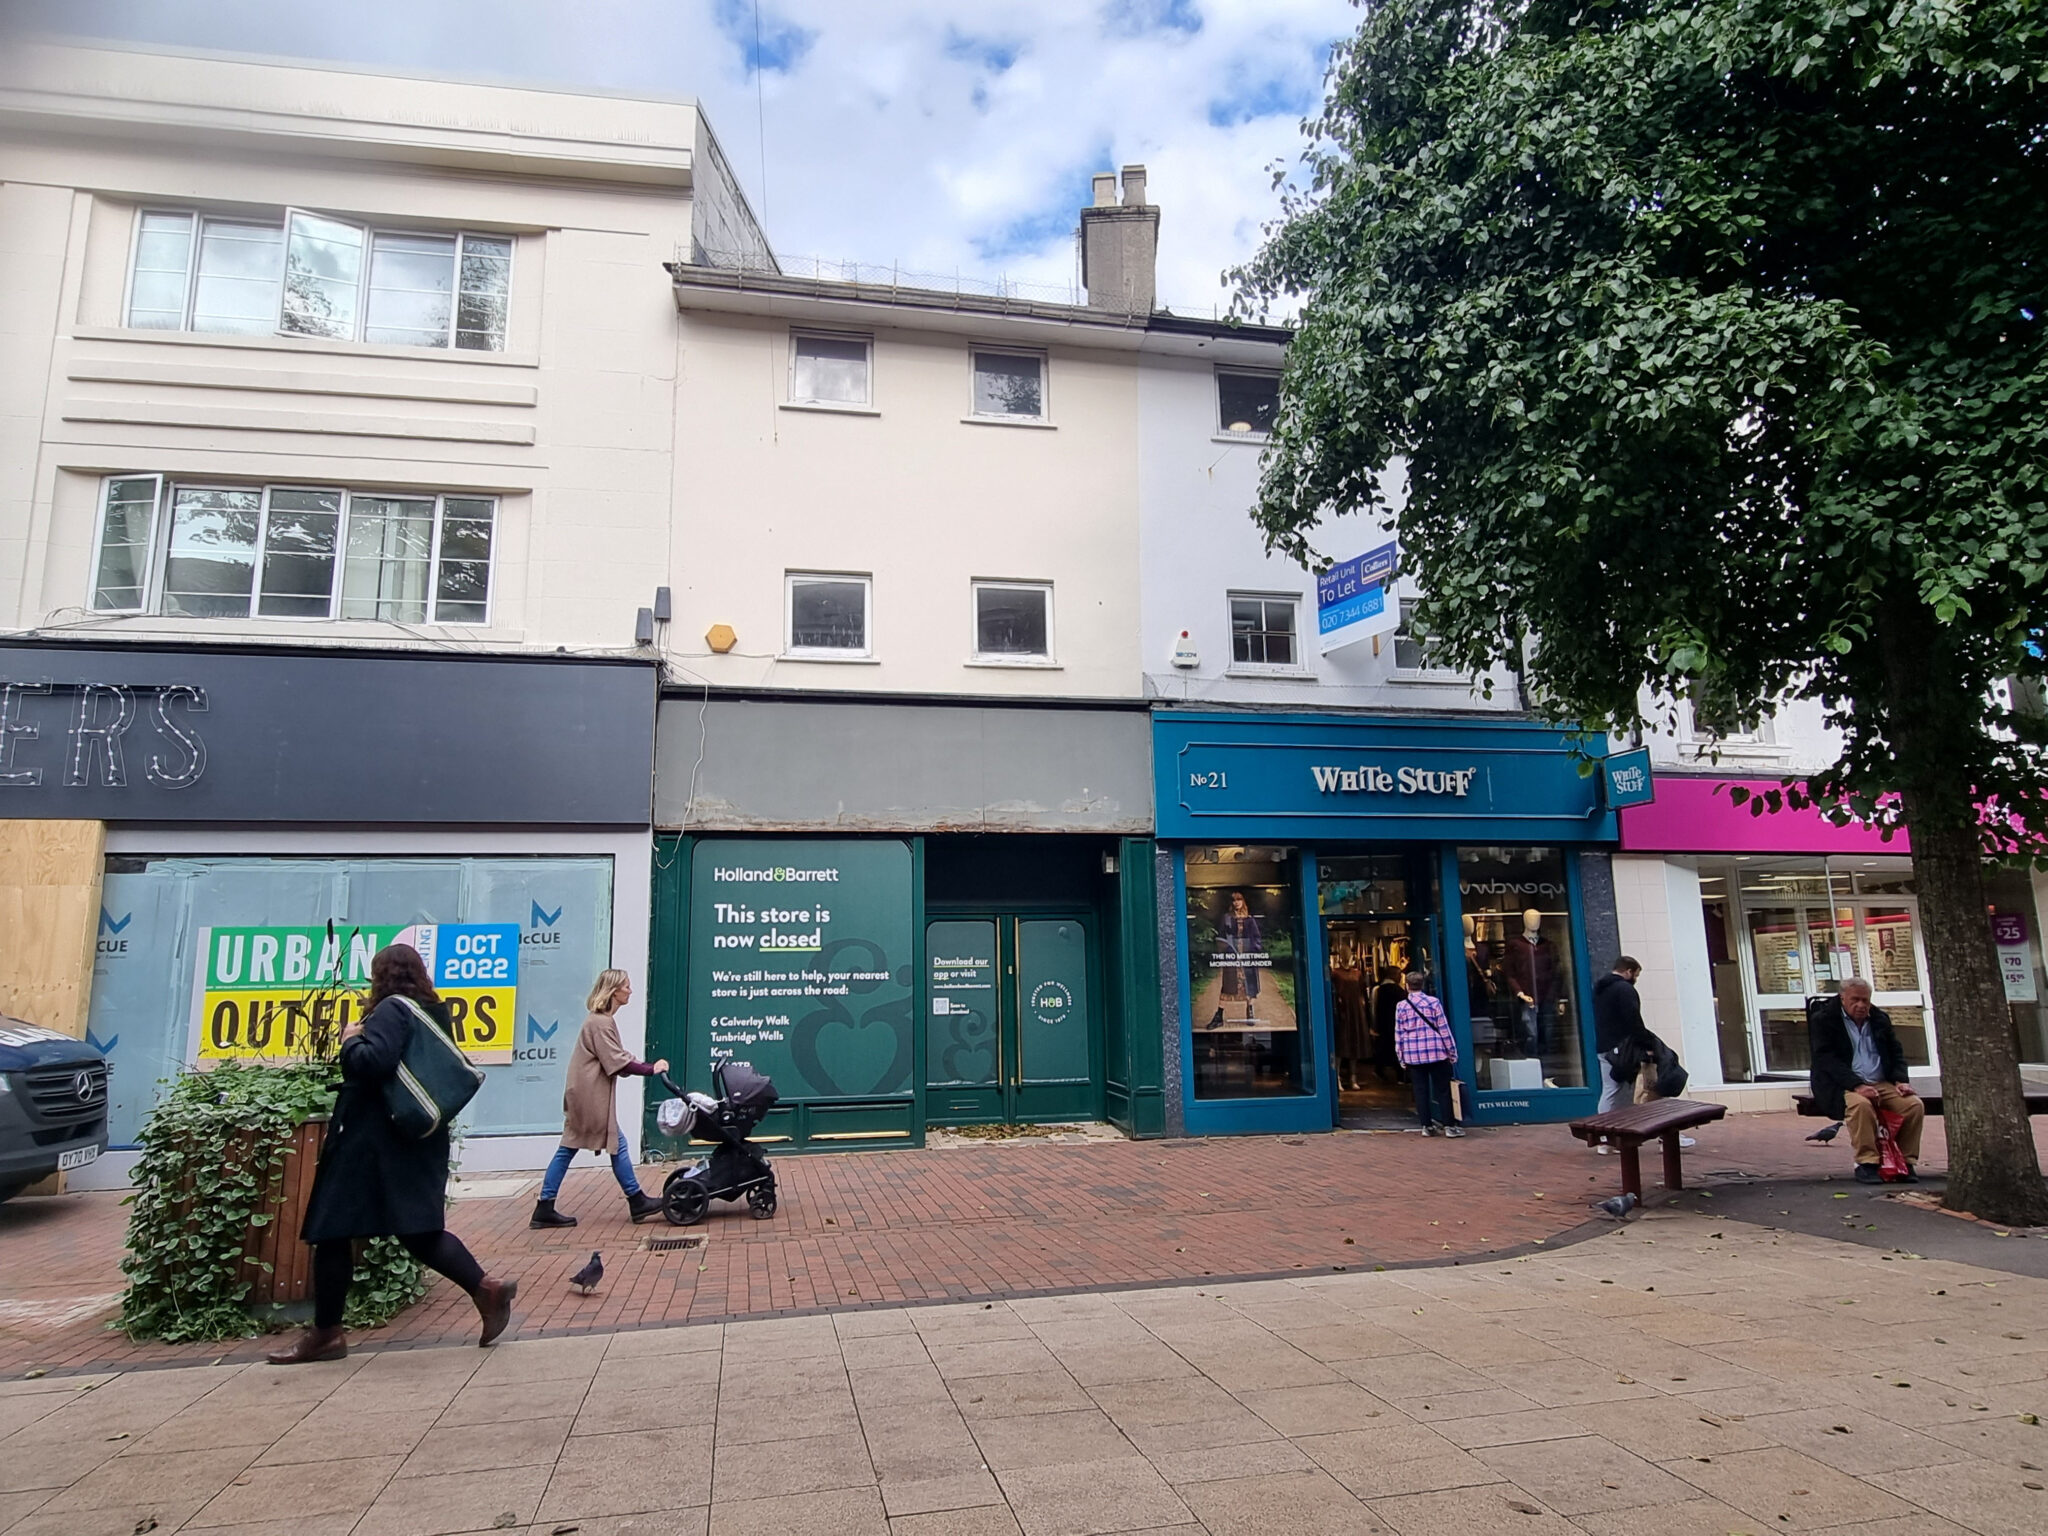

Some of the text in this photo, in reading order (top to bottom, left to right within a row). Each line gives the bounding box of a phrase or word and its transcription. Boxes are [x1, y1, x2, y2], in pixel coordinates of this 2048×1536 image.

[1320, 564, 1355, 587] Retail Unit
[1320, 578, 1356, 604] To Let
[1321, 596, 1384, 630] 020 7344 6881
[713, 903, 831, 924] This store is
[713, 927, 822, 952] now closed
[1996, 927, 2021, 940] £25
[96, 940, 129, 953] CUE
[455, 935, 502, 956] OCT
[216, 933, 377, 984] URBAN
[934, 956, 974, 966] Download
[1212, 951, 1270, 960] THE NO MEETINGS
[2004, 957, 2022, 967] £70
[444, 958, 509, 980] 2022
[1209, 960, 1272, 968] MORNING MEANDER
[743, 970, 761, 982] still
[764, 971, 786, 982] here
[788, 971, 800, 982] to
[801, 969, 826, 984] help,
[828, 972, 851, 984] your
[852, 971, 890, 981] nearest
[933, 971, 949, 981] app
[960, 969, 977, 978] visit
[711, 984, 849, 1001] store is just across the road:
[211, 995, 497, 1050] OUTFIRS
[711, 1015, 790, 1029] 6 Calverley Walk
[710, 1030, 784, 1045] Tunbridge Wells
[710, 1047, 734, 1058] Kent
[1478, 1100, 1530, 1110] PETS WELCOME
